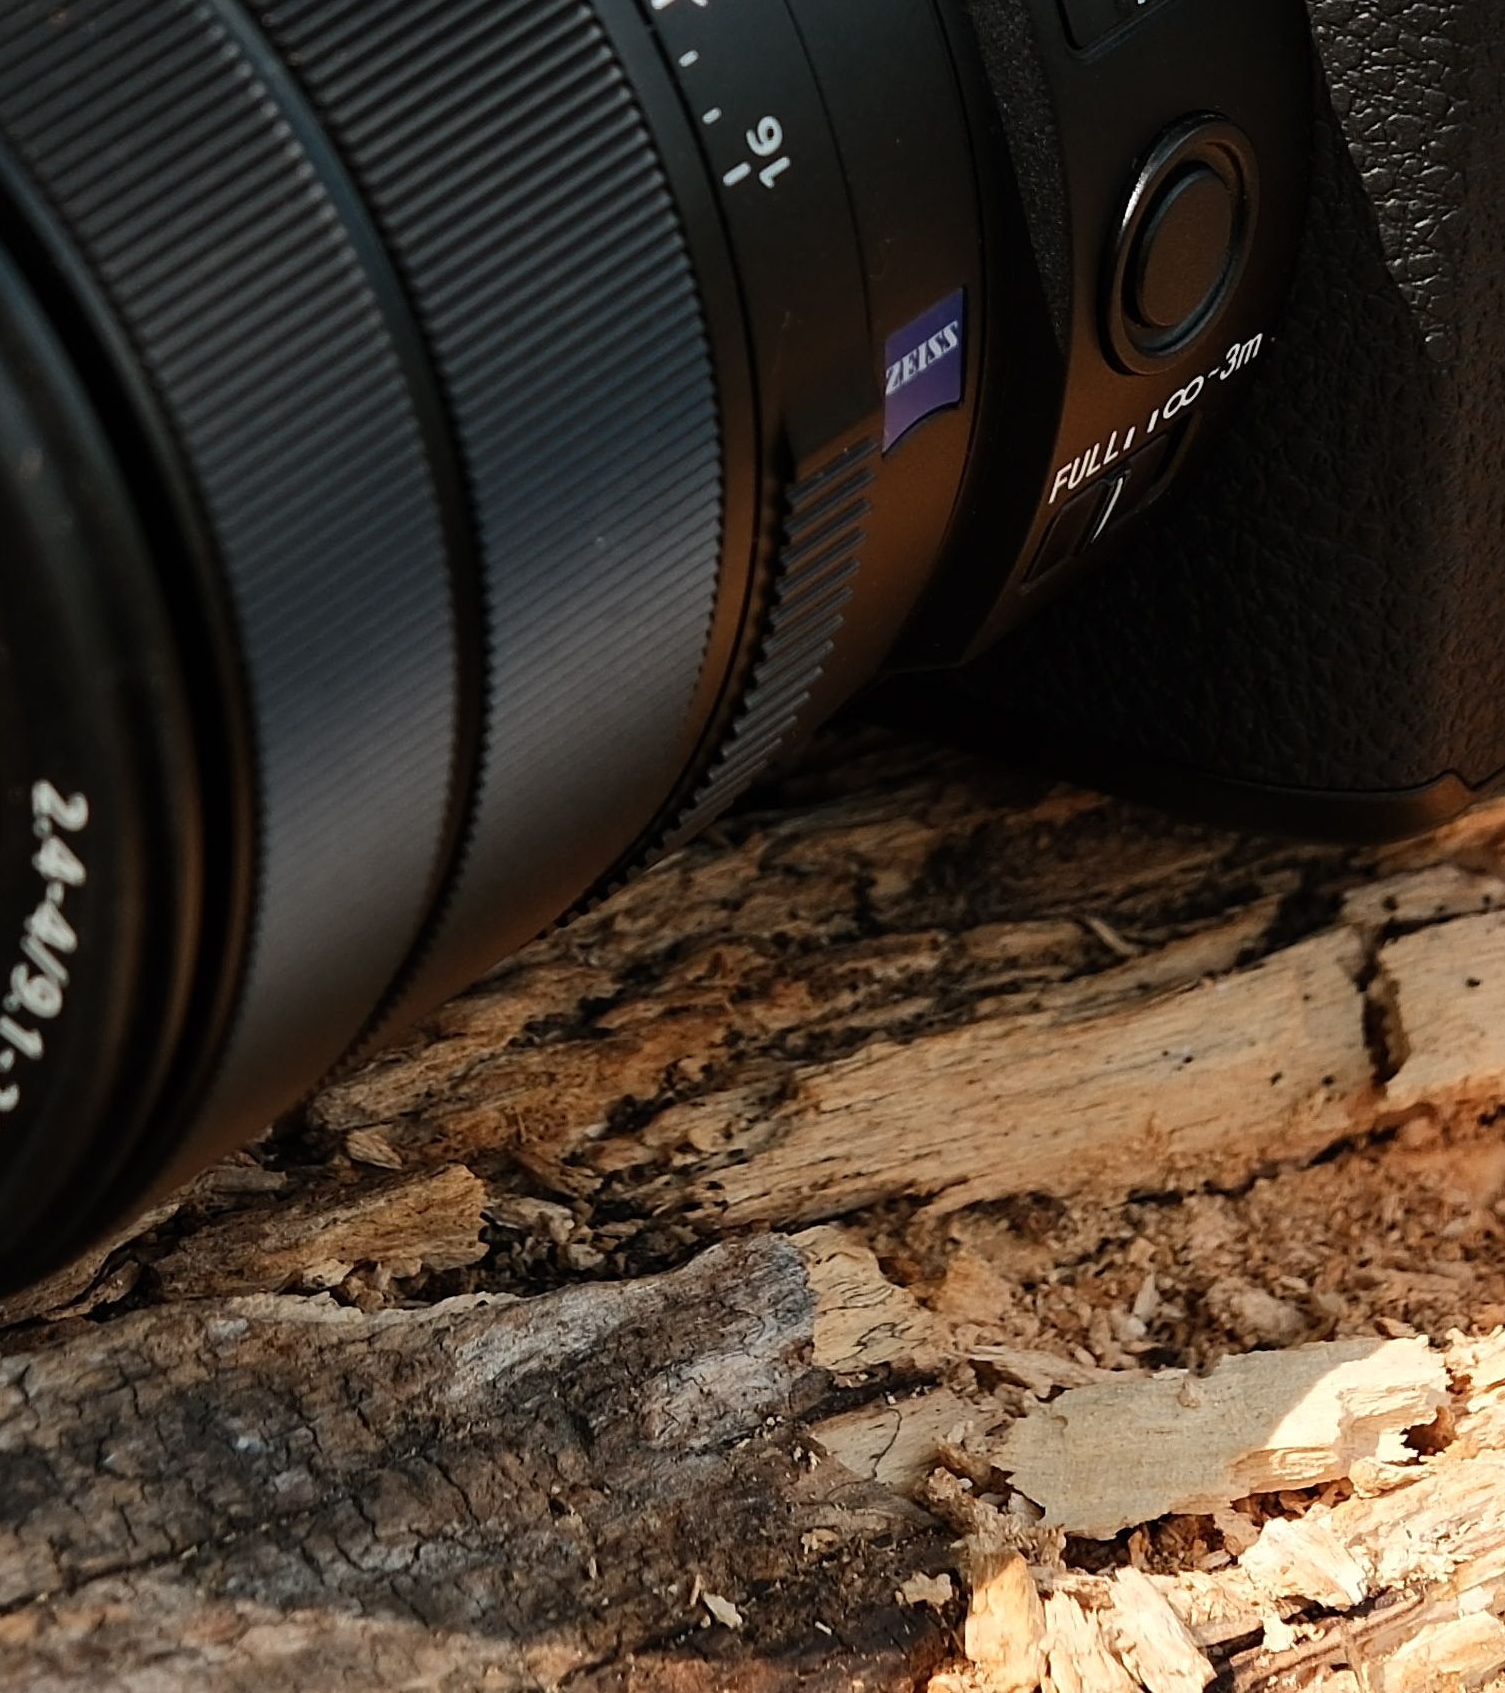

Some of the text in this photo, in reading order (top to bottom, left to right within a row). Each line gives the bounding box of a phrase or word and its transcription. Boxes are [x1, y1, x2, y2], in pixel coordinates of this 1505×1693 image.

[746, 115, 791, 189] 16
[885, 324, 958, 395] ZEISS
[1048, 430, 1118, 505] FULL
